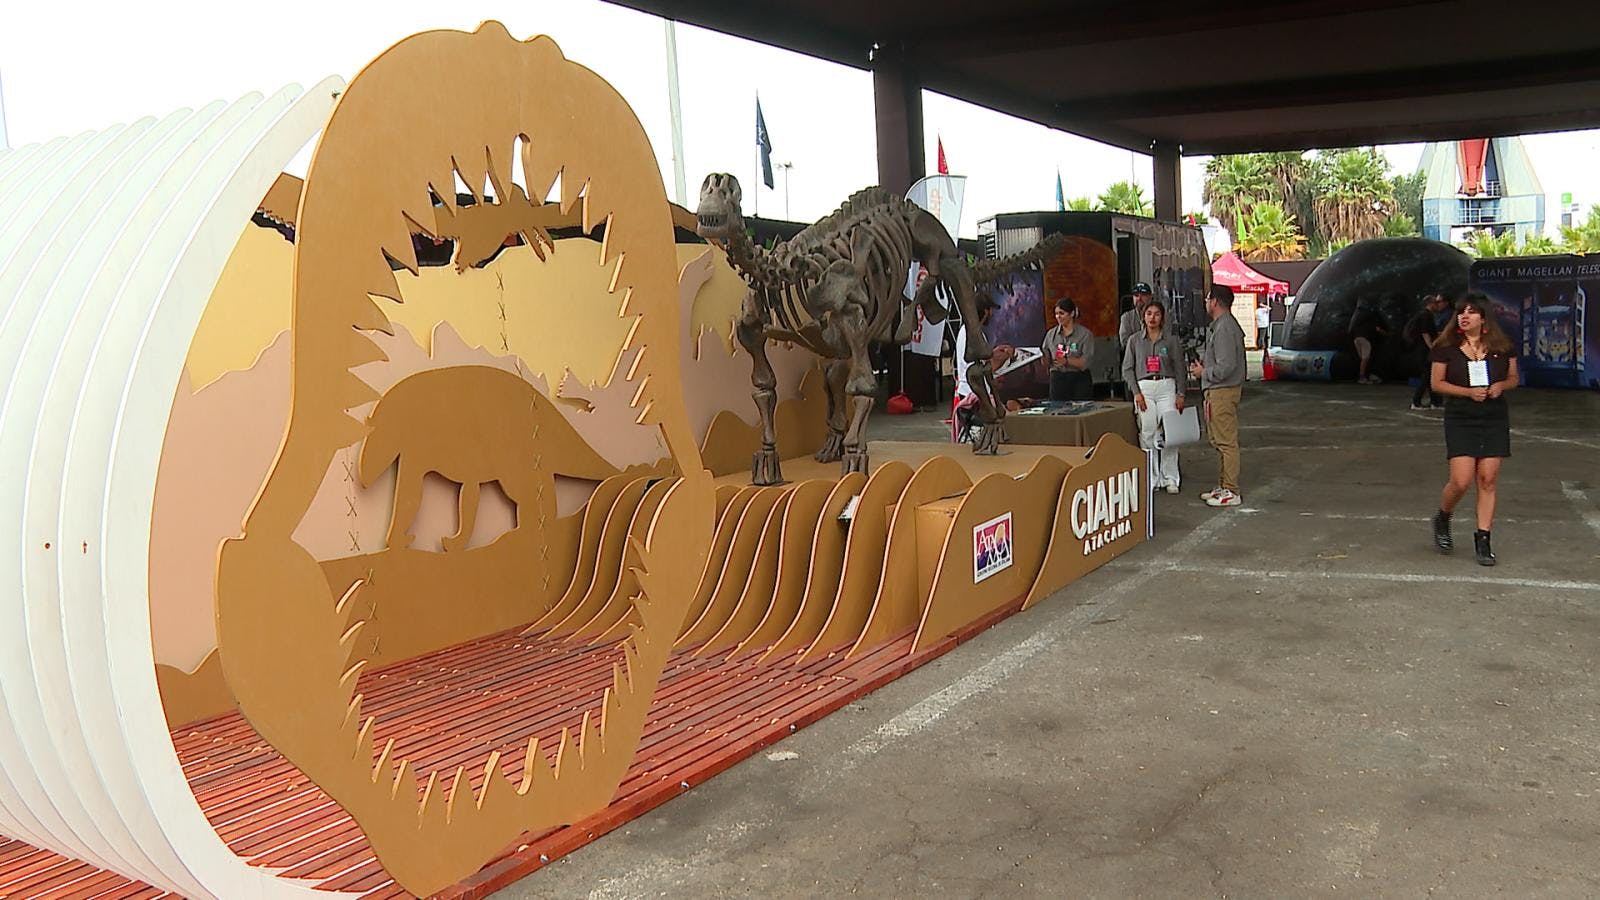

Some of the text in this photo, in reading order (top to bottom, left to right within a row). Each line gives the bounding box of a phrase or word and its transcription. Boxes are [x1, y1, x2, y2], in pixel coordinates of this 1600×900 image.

[1478, 267, 1511, 278] GIANT
[1518, 265, 1573, 277] MAGELLAN
[1071, 468, 1139, 540] CIAHN
